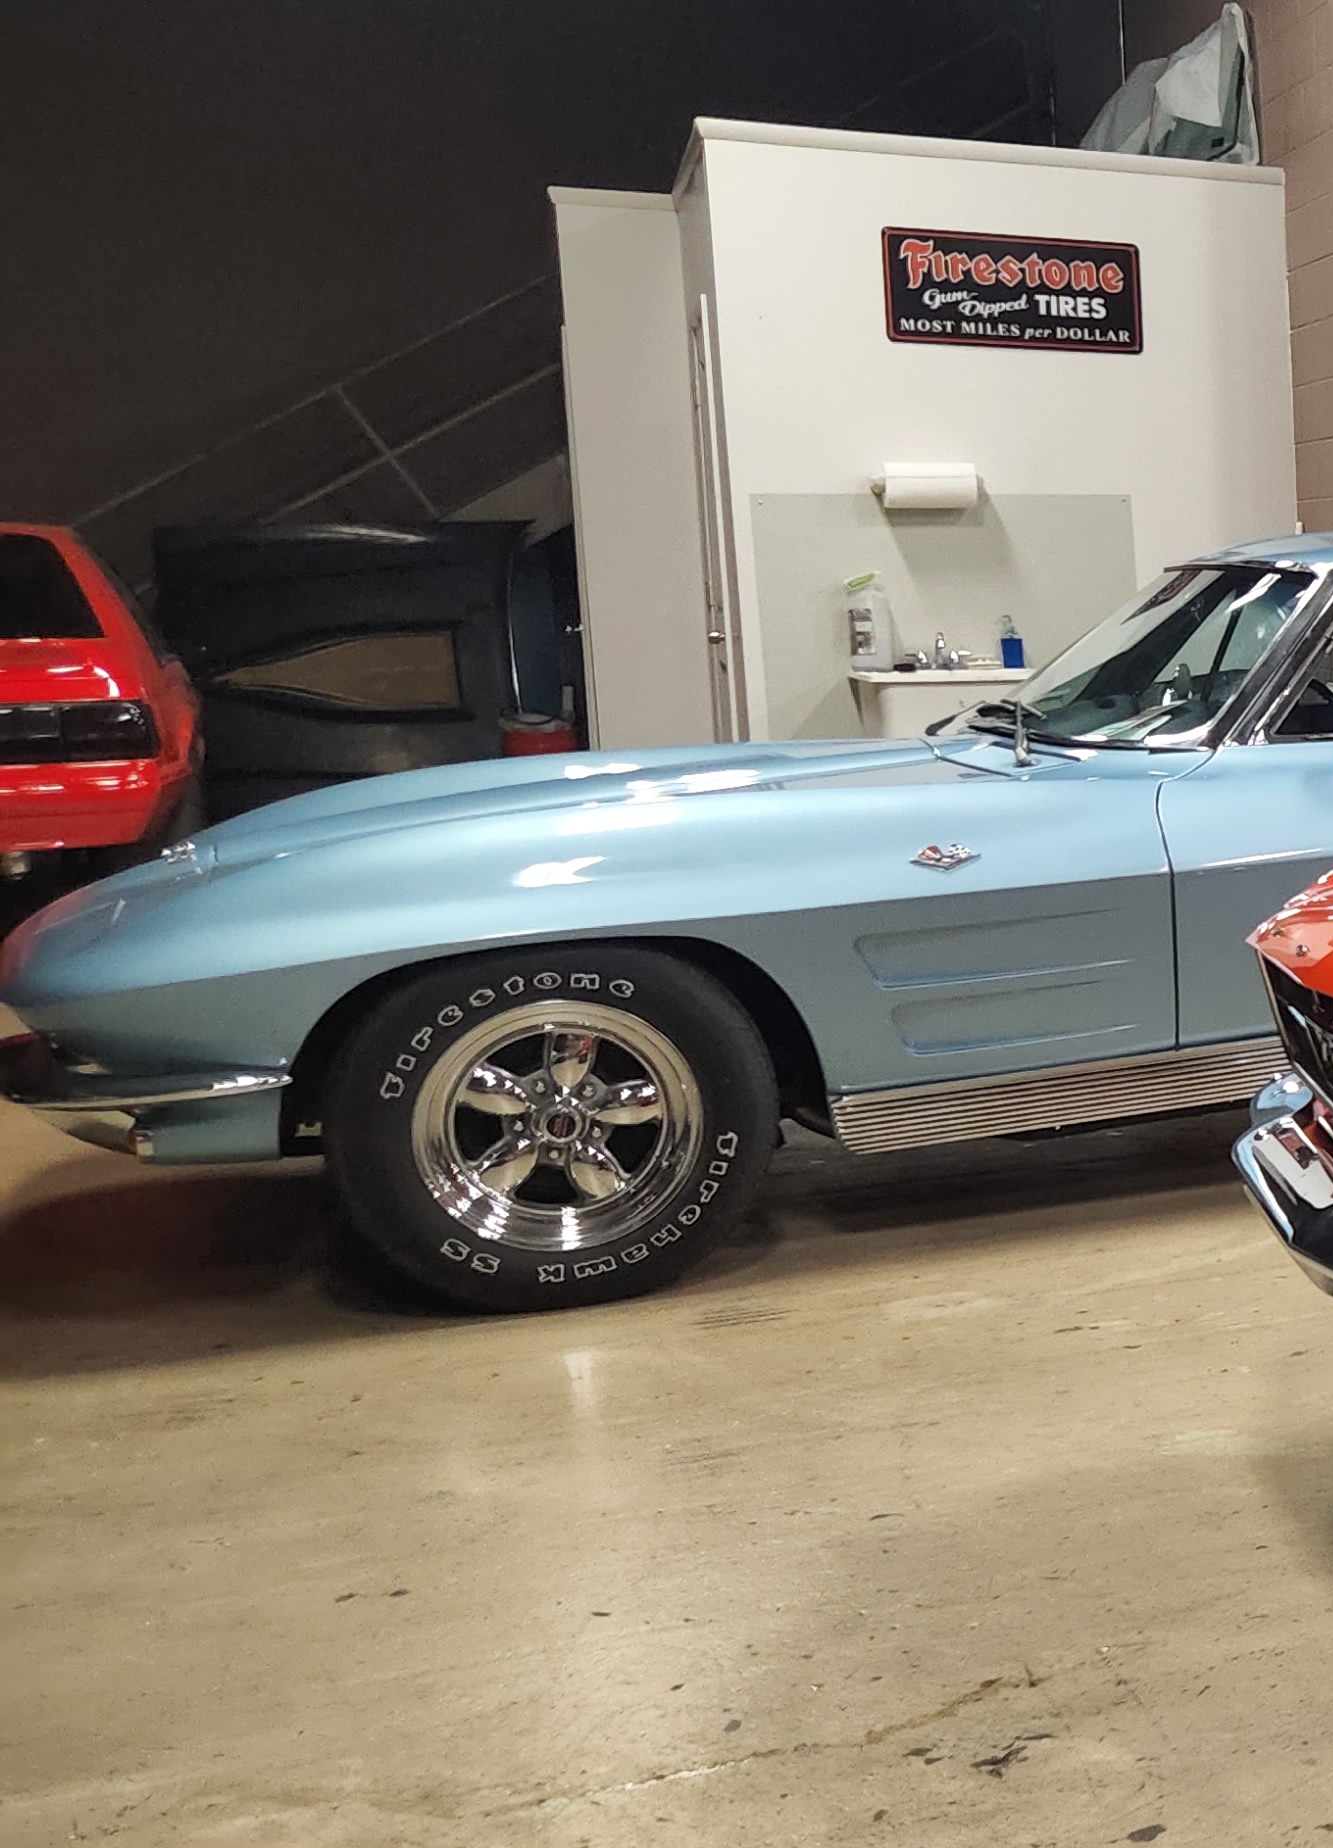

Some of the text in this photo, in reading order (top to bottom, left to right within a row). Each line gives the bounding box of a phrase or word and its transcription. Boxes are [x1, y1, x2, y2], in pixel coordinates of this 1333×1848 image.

[899, 238, 1124, 294] Firestone
[900, 317, 1131, 343] MOST MILES per DOLLAR
[958, 294, 1029, 318] Dipped
[1033, 294, 1107, 319] TIRES
[379, 971, 636, 1100] Firestone
[440, 1130, 740, 1284] Firehawk SS
